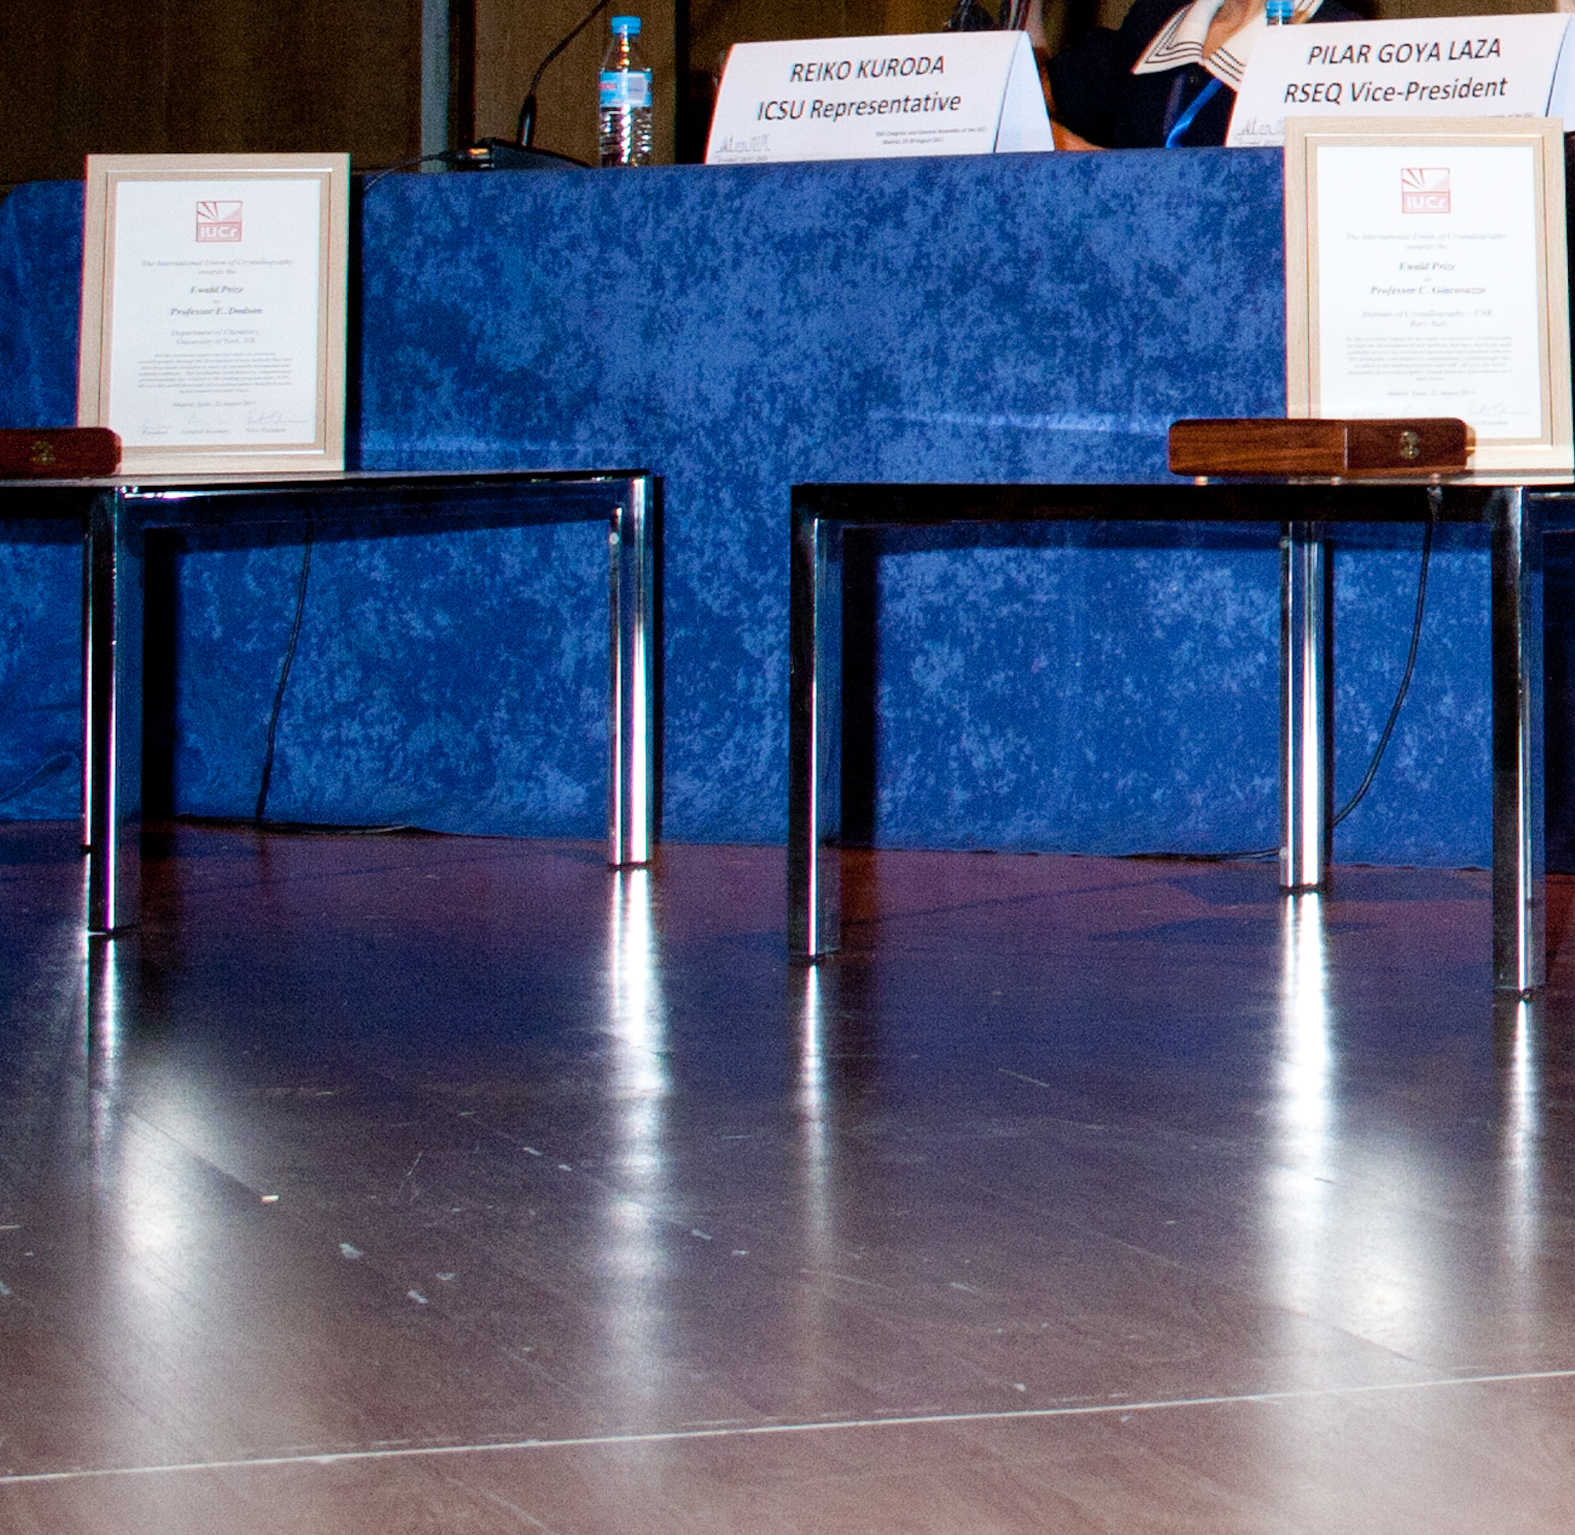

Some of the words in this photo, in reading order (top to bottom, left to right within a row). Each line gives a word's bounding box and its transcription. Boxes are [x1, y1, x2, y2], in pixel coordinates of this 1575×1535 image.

[1308, 44, 1371, 64] PILAR
[1378, 42, 1440, 63] GOYA
[1448, 38, 1500, 60] LAZA
[790, 61, 851, 82] REIKO
[857, 56, 943, 78] KURODA
[1284, 83, 1342, 105] RSEQ
[1352, 77, 1508, 102] Vice-President
[758, 101, 805, 120] ICSU
[810, 93, 961, 122] Representative
